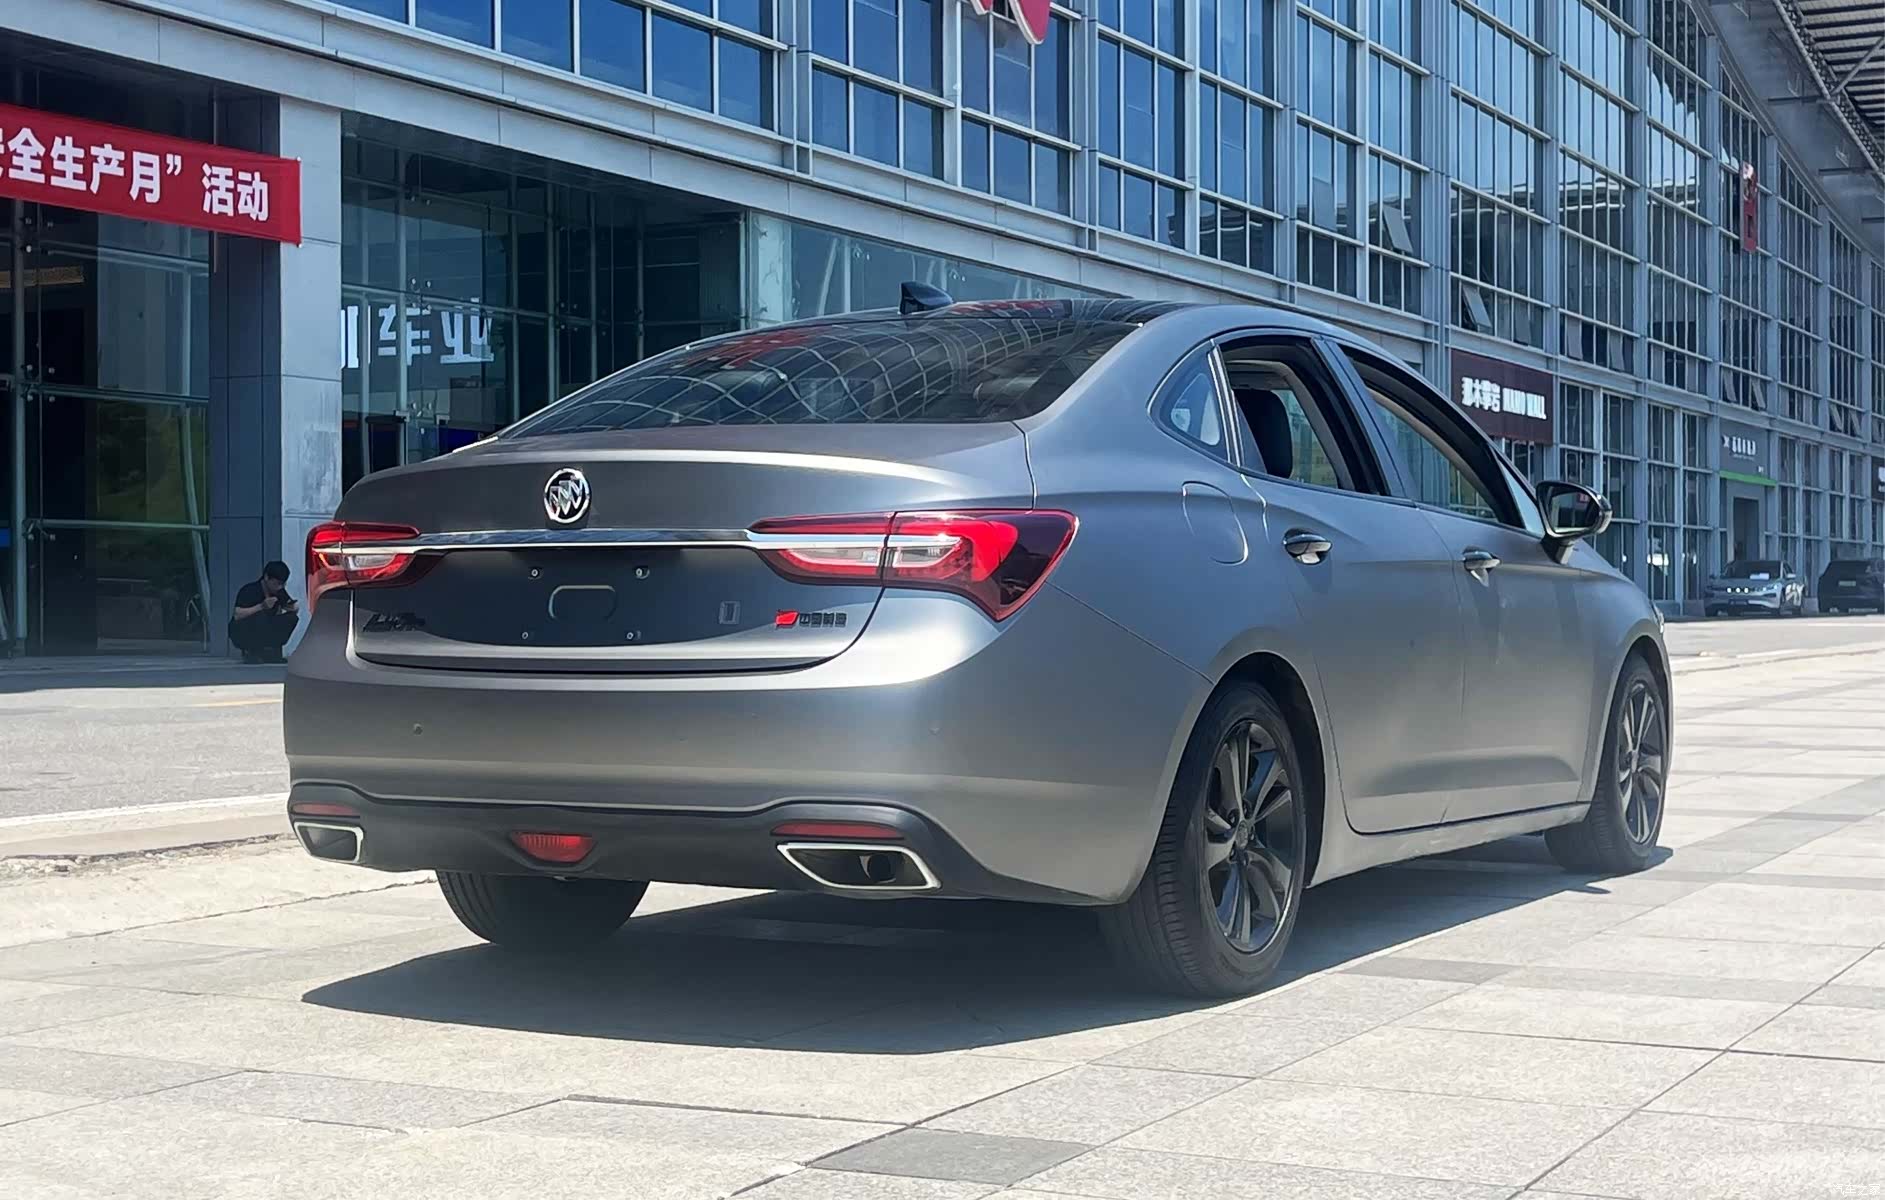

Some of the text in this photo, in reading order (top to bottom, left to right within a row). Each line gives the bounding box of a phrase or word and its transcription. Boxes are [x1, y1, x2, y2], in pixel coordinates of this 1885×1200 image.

[0, 127, 269, 222] 全生产月”活动
